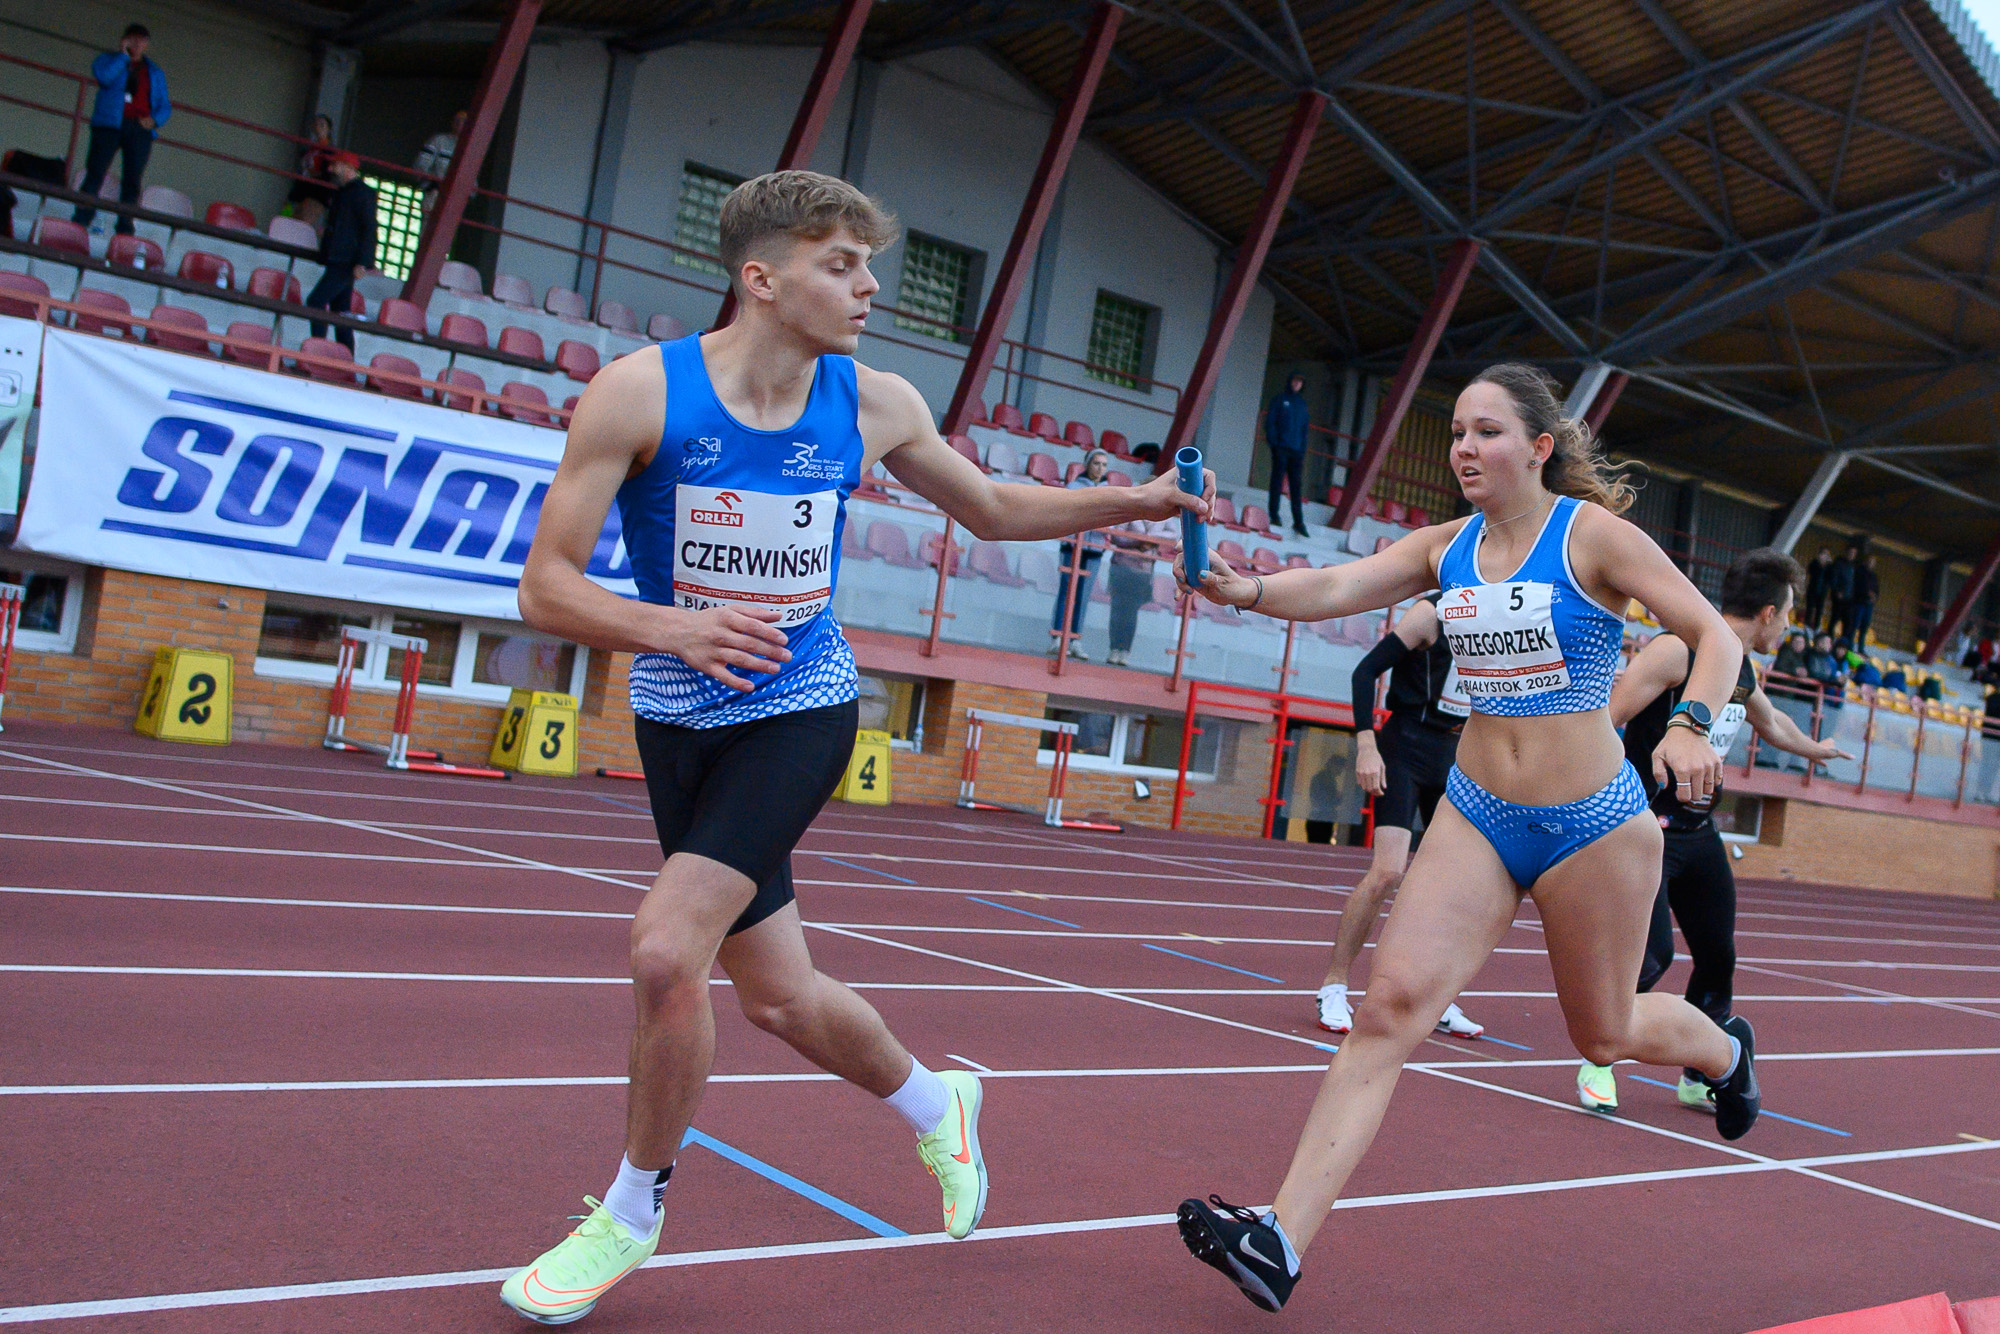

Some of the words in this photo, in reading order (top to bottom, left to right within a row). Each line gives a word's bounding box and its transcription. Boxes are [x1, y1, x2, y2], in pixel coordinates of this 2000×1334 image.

[782, 469, 845, 481] DŁUGOŁĘKA
[117, 416, 634, 579] SONA
[693, 511, 741, 526] ORLEN
[793, 499, 813, 529] 3
[681, 540, 829, 579] CZERWIŃSKI
[678, 582, 698, 592] PZLA
[698, 587, 753, 600] MISTRZOSTWA
[753, 594, 781, 602] POLSKI
[782, 595, 791, 603] W
[1509, 586, 1524, 611] 5
[786, 603, 822, 622] 2022
[1446, 607, 1475, 618] ORLEN
[1448, 626, 1553, 657] GRZEGORZEK
[1463, 679, 1523, 693] BIAŁYSTOK
[1526, 674, 1562, 690] 2022
[179, 673, 217, 725] 2
[1725, 707, 1744, 722] 214
[502, 706, 525, 752] 3
[540, 720, 565, 759] 3
[859, 755, 877, 790] 4
